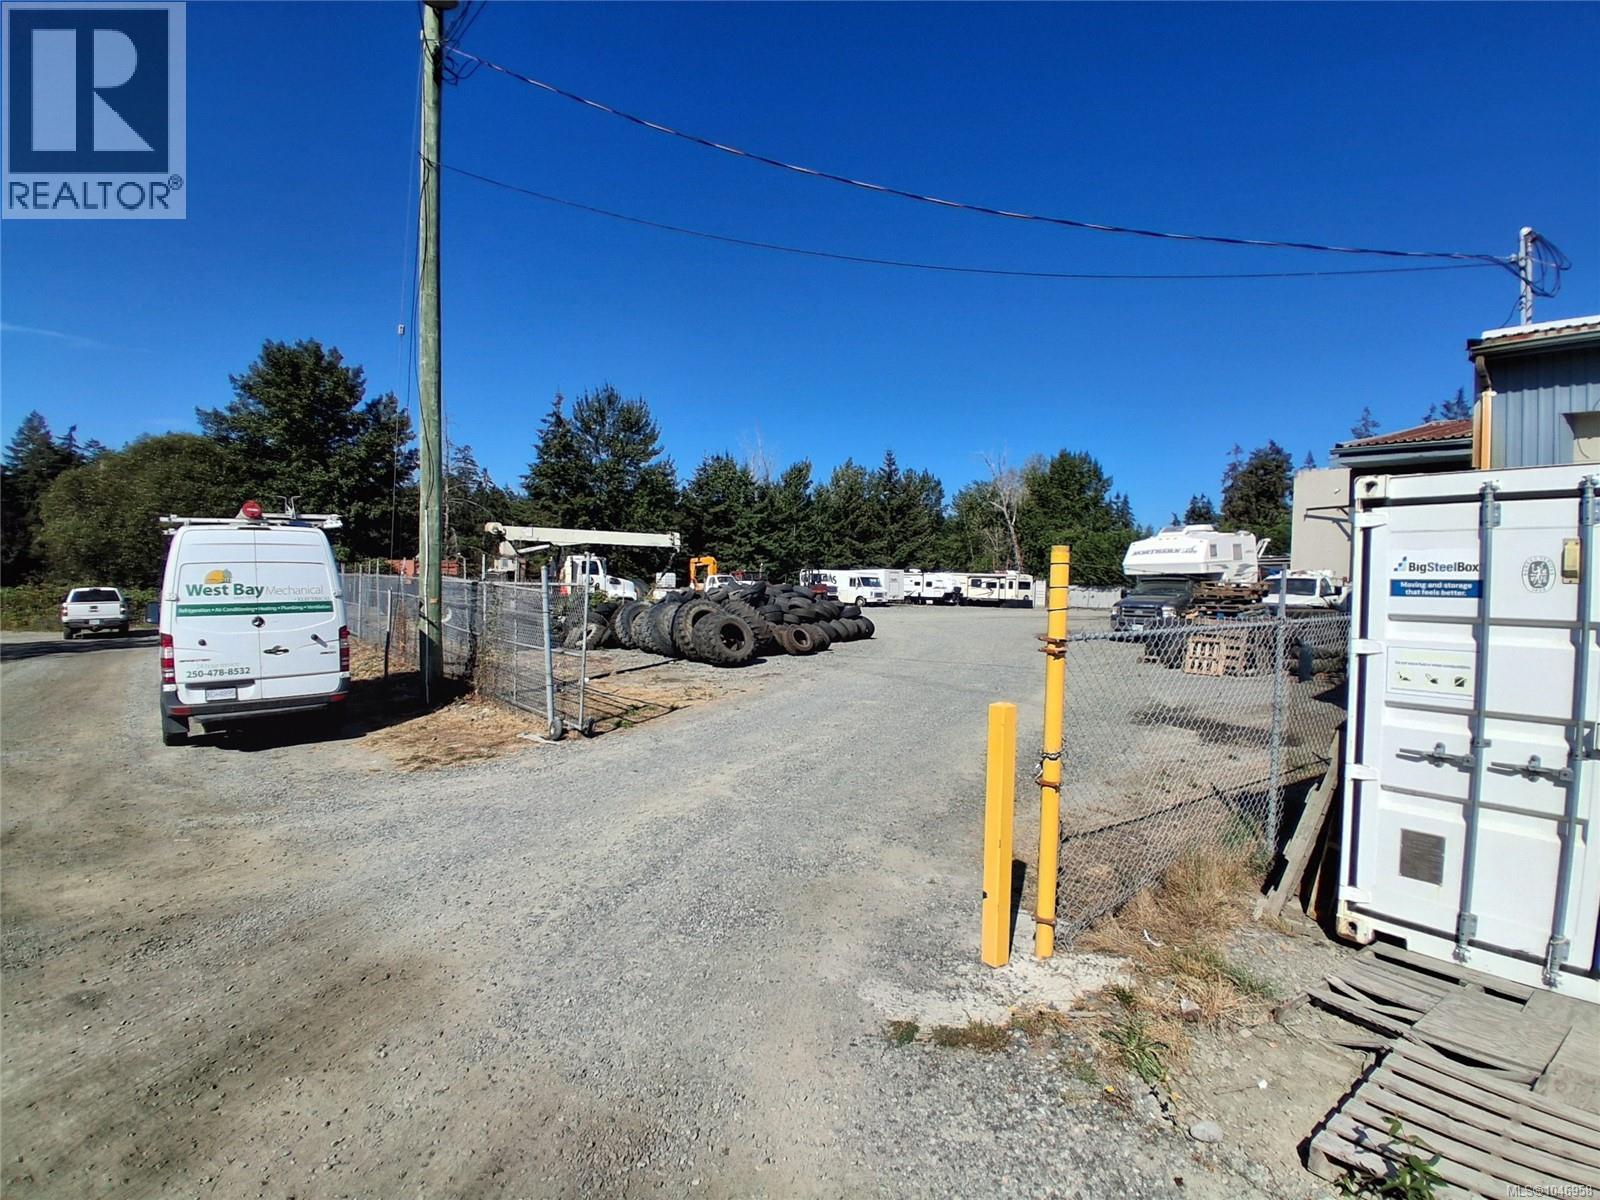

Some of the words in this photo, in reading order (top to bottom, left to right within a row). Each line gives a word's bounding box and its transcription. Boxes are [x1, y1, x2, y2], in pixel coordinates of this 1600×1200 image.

[1408, 562, 1480, 574] BigSteelBox
[186, 584, 229, 596] West
[233, 583, 264, 598] Bay
[265, 584, 323, 595] Mechanical
[1400, 581, 1426, 589] Moving
[1443, 582, 1472, 590] storage
[186, 666, 251, 678] 250-478-8532
